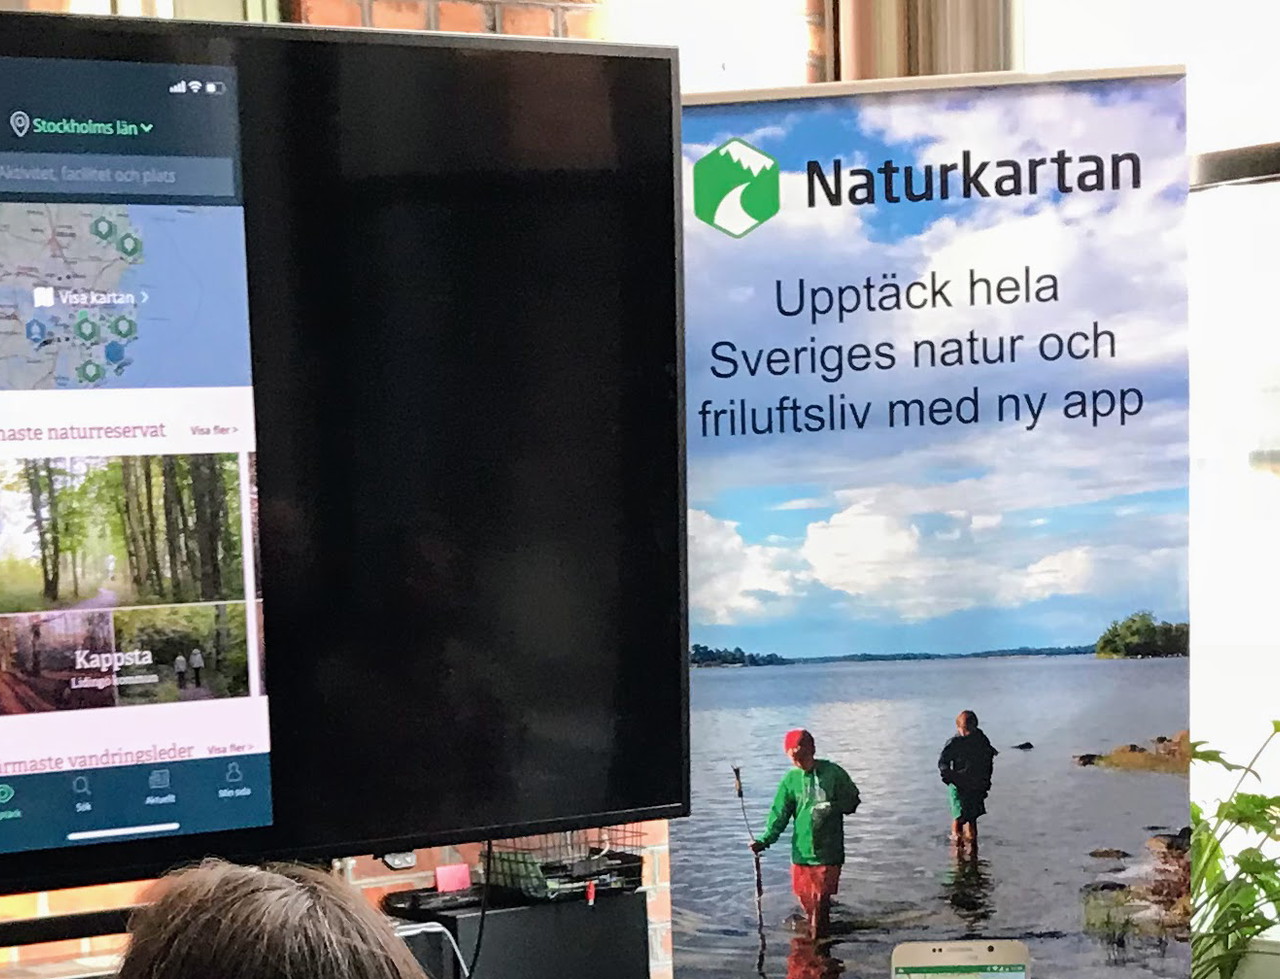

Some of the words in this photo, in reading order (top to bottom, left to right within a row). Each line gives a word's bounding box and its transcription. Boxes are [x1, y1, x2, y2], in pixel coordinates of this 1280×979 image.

[32, 118, 114, 135] Stockholms
[116, 119, 138, 136] län
[115, 167, 140, 182] och
[805, 150, 1142, 208] Naturkartan
[58, 291, 89, 304] Visa
[90, 291, 134, 304] kartan
[775, 270, 952, 324] Upptäck
[969, 266, 1059, 306] hela
[709, 337, 896, 384] Sveriges
[913, 329, 1023, 367] natur
[1038, 321, 1116, 362] och
[698, 393, 872, 438] friluftsliv
[888, 386, 980, 427] med
[998, 390, 1048, 431] ny
[1063, 386, 1143, 427] app
[47, 422, 166, 440] naturreservat
[74, 649, 153, 672] Kappsta
[67, 744, 195, 768] vandringsleder
